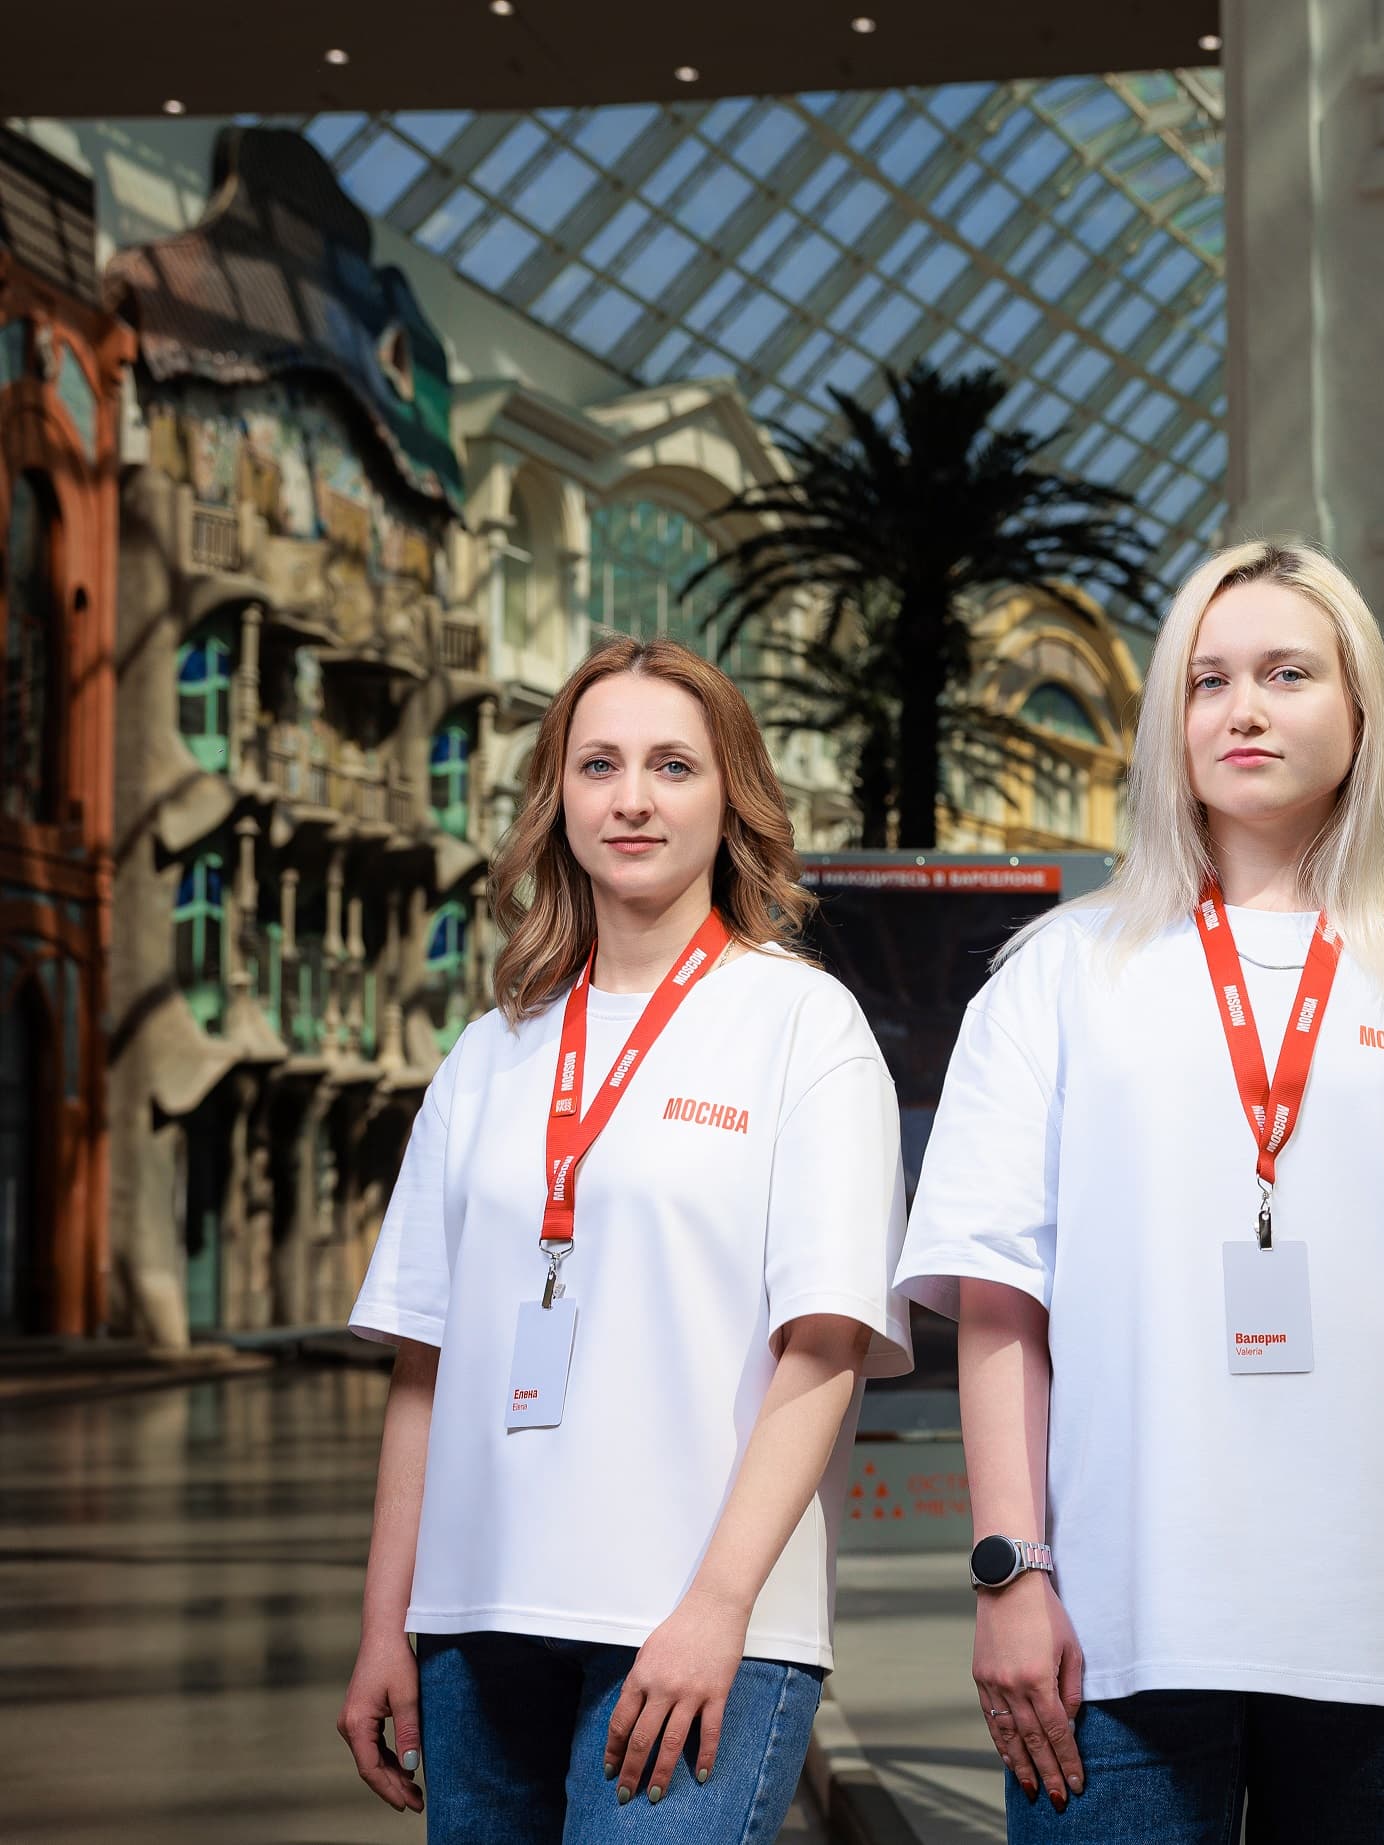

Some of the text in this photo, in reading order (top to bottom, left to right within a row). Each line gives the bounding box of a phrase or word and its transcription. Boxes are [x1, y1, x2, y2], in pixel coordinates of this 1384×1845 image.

[823, 870, 930, 888] НАХОДИТЕСЬ
[933, 870, 945, 887] В
[951, 870, 1047, 888] БАРСЕЛОНЕ
[672, 947, 708, 987] MOSCOW
[1223, 984, 1246, 1027] MOSCOW
[1296, 997, 1319, 1033] МОСКВА
[560, 1051, 577, 1092] MOSCOW
[609, 1048, 640, 1088] МОСКВА
[663, 1097, 749, 1135] МОСКВА
[1266, 1103, 1290, 1153] MOSCOW
[553, 1155, 575, 1201] MOSCOW
[1235, 1332, 1287, 1346] Валерия
[1235, 1347, 1263, 1356] Valeria
[514, 1389, 538, 1399] Елена
